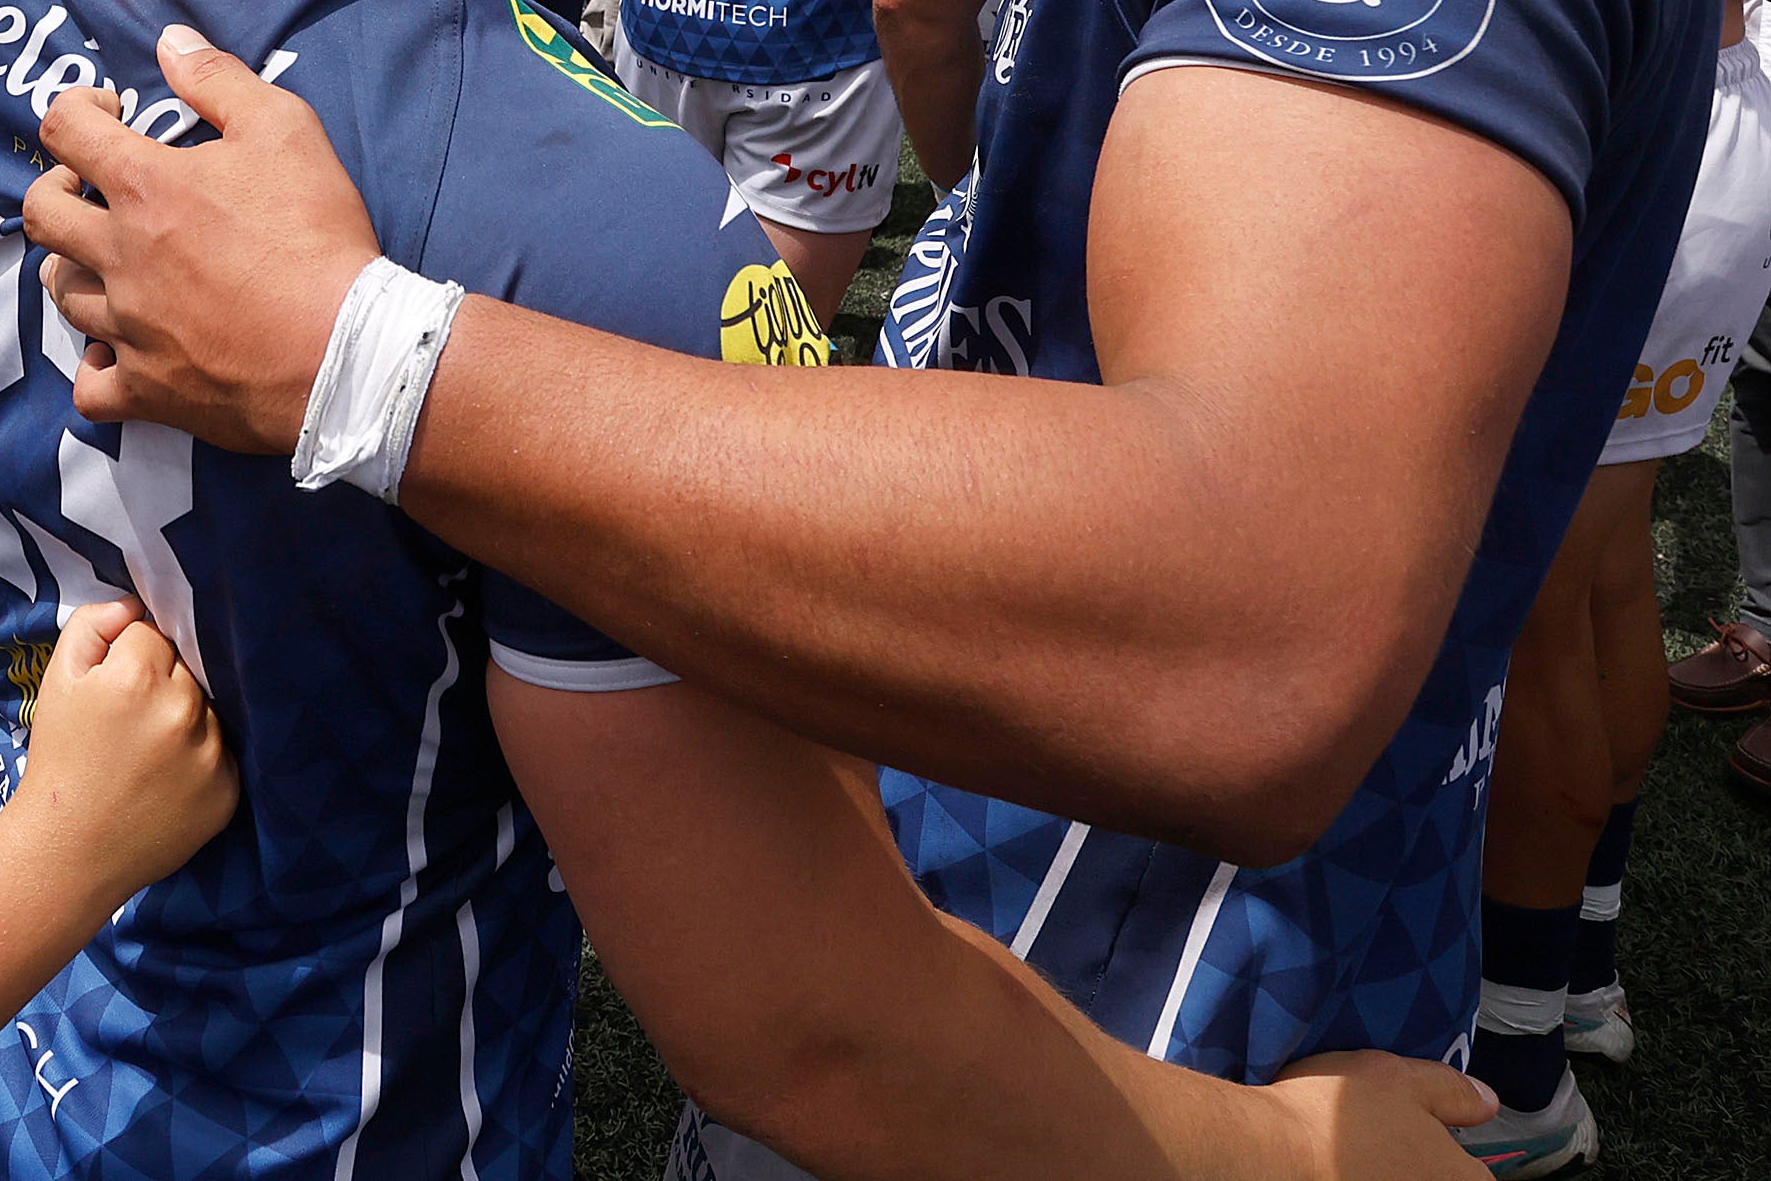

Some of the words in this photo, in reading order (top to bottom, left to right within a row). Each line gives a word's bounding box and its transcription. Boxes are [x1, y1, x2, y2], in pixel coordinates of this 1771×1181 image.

[1233, 7, 1337, 63] DESDE
[1359, 33, 1439, 69] 1994
[1699, 335, 1734, 367] fit
